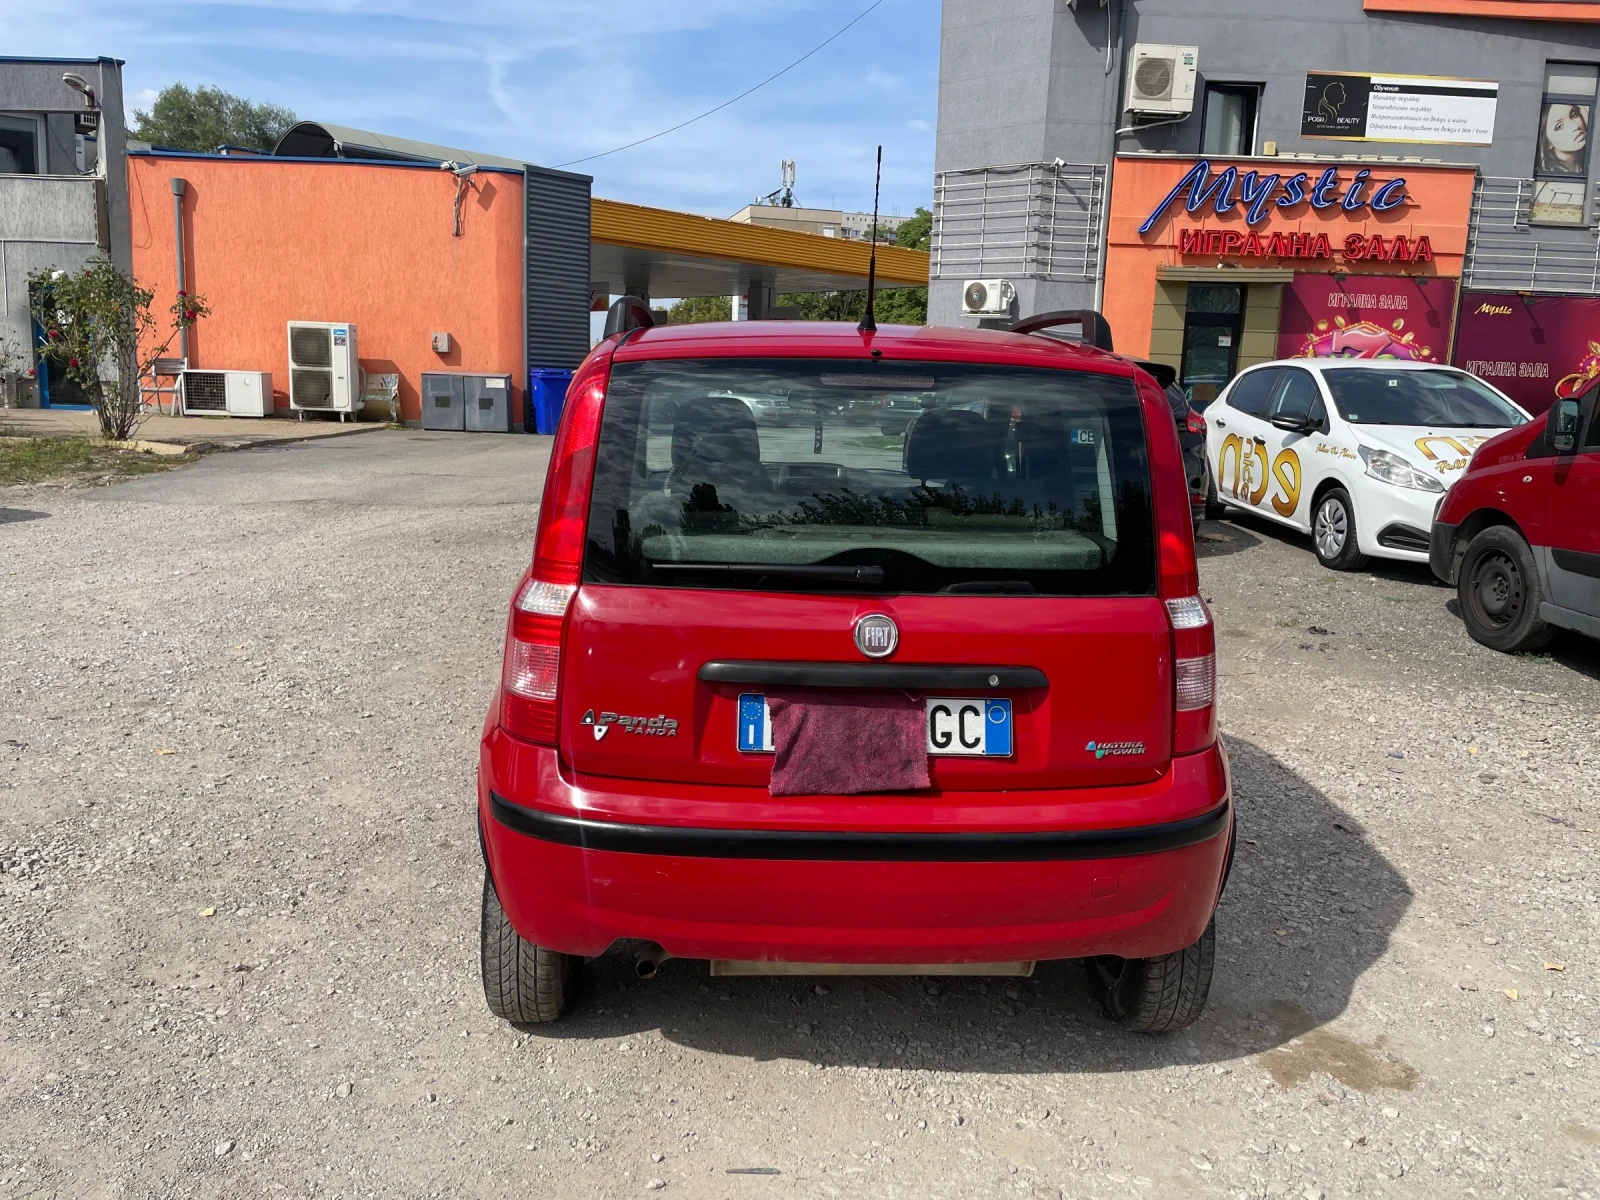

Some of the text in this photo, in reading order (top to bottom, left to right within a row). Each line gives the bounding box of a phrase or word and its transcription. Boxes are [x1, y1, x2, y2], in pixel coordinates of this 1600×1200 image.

[1373, 84, 1400, 92] Обучения:
[1138, 159, 1407, 233] Mystic
[1178, 228, 1432, 261] ИГРАЛНА ЗАЛА
[1328, 292, 1408, 310] ИГРАЛНА ЗАЛА
[1473, 302, 1512, 316] Mystic
[1465, 360, 1549, 378] ИГРАЛНА ЗАЛА
[1435, 458, 1467, 474] Foll
[864, 626, 890, 647] FIAT
[598, 711, 679, 729] Panda
[930, 704, 982, 749] GC
[624, 726, 677, 736] PANDA
[1096, 741, 1144, 749] NATURA
[1104, 747, 1147, 756] POWER
